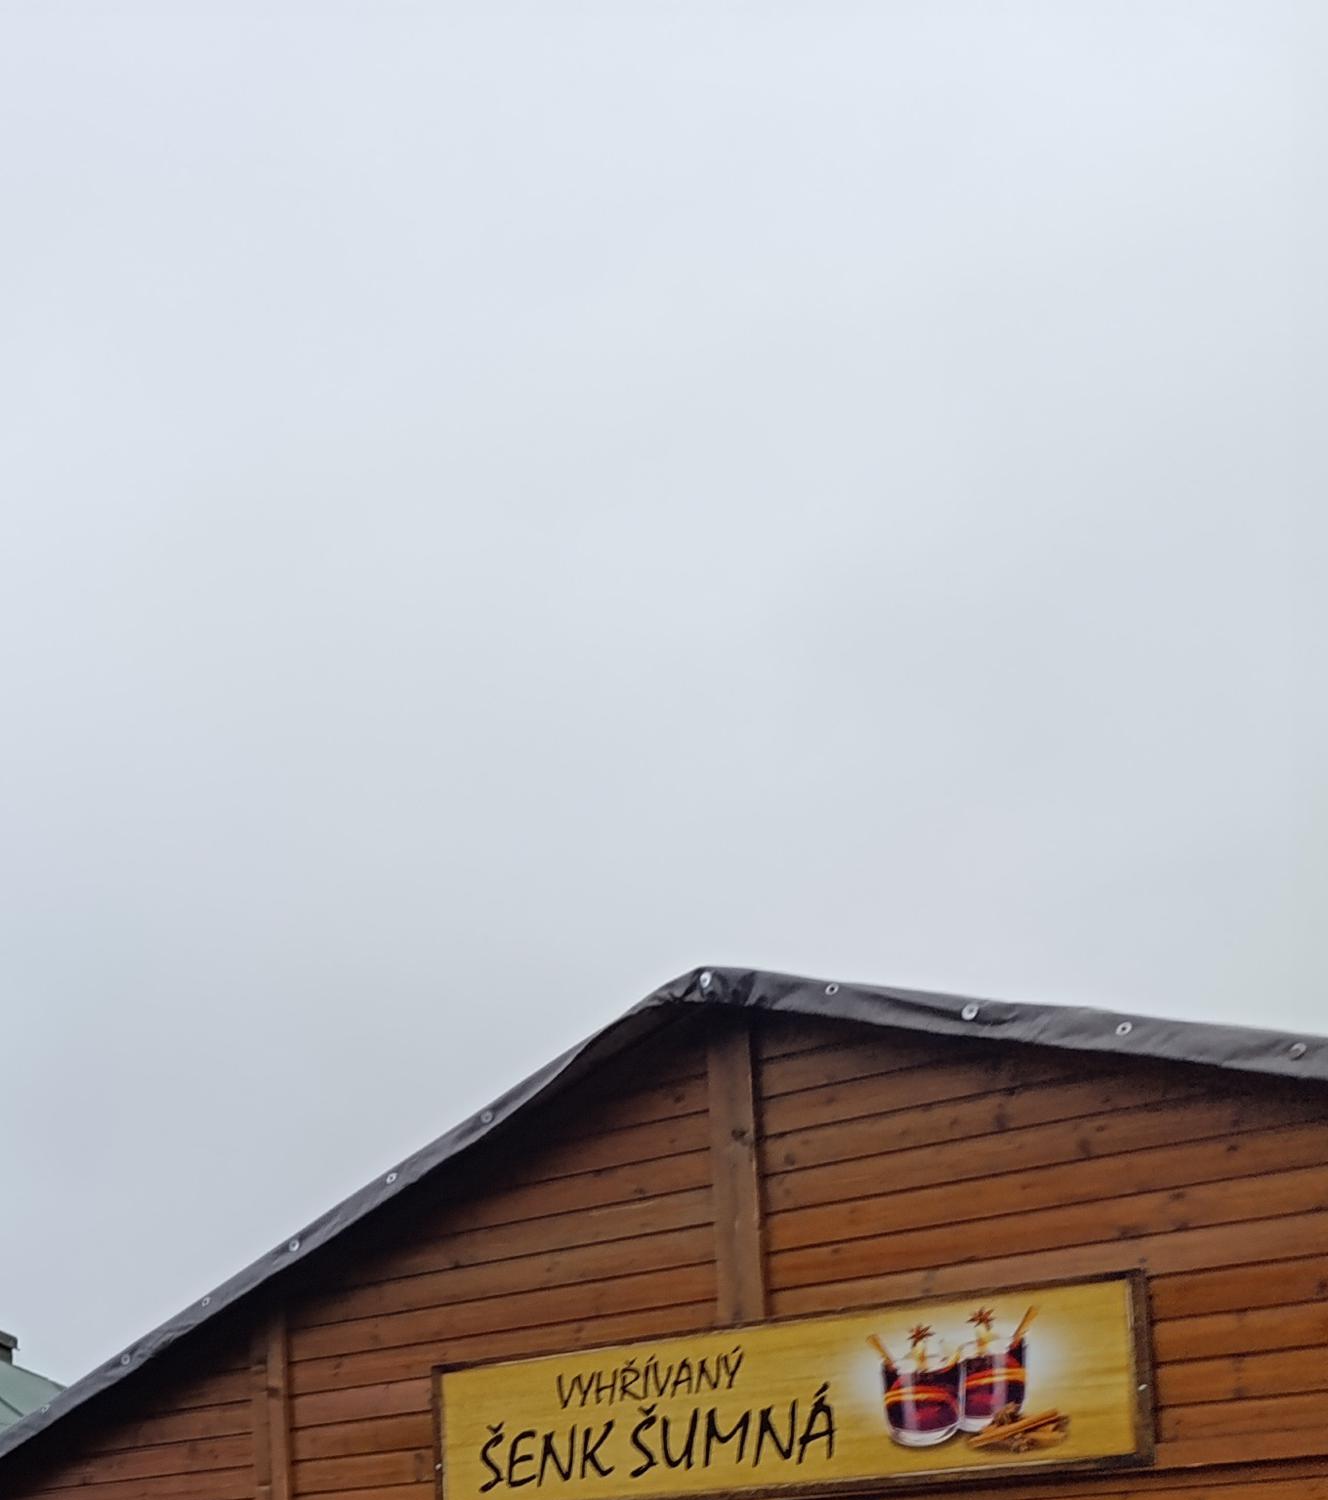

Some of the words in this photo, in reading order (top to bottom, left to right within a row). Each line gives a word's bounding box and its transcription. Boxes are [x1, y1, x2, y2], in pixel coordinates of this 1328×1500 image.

[556, 1345, 743, 1409] VYHŘÍVANÝ
[479, 1420, 616, 1494] ŠENK
[630, 1382, 837, 1478] ŠUMNÁ
